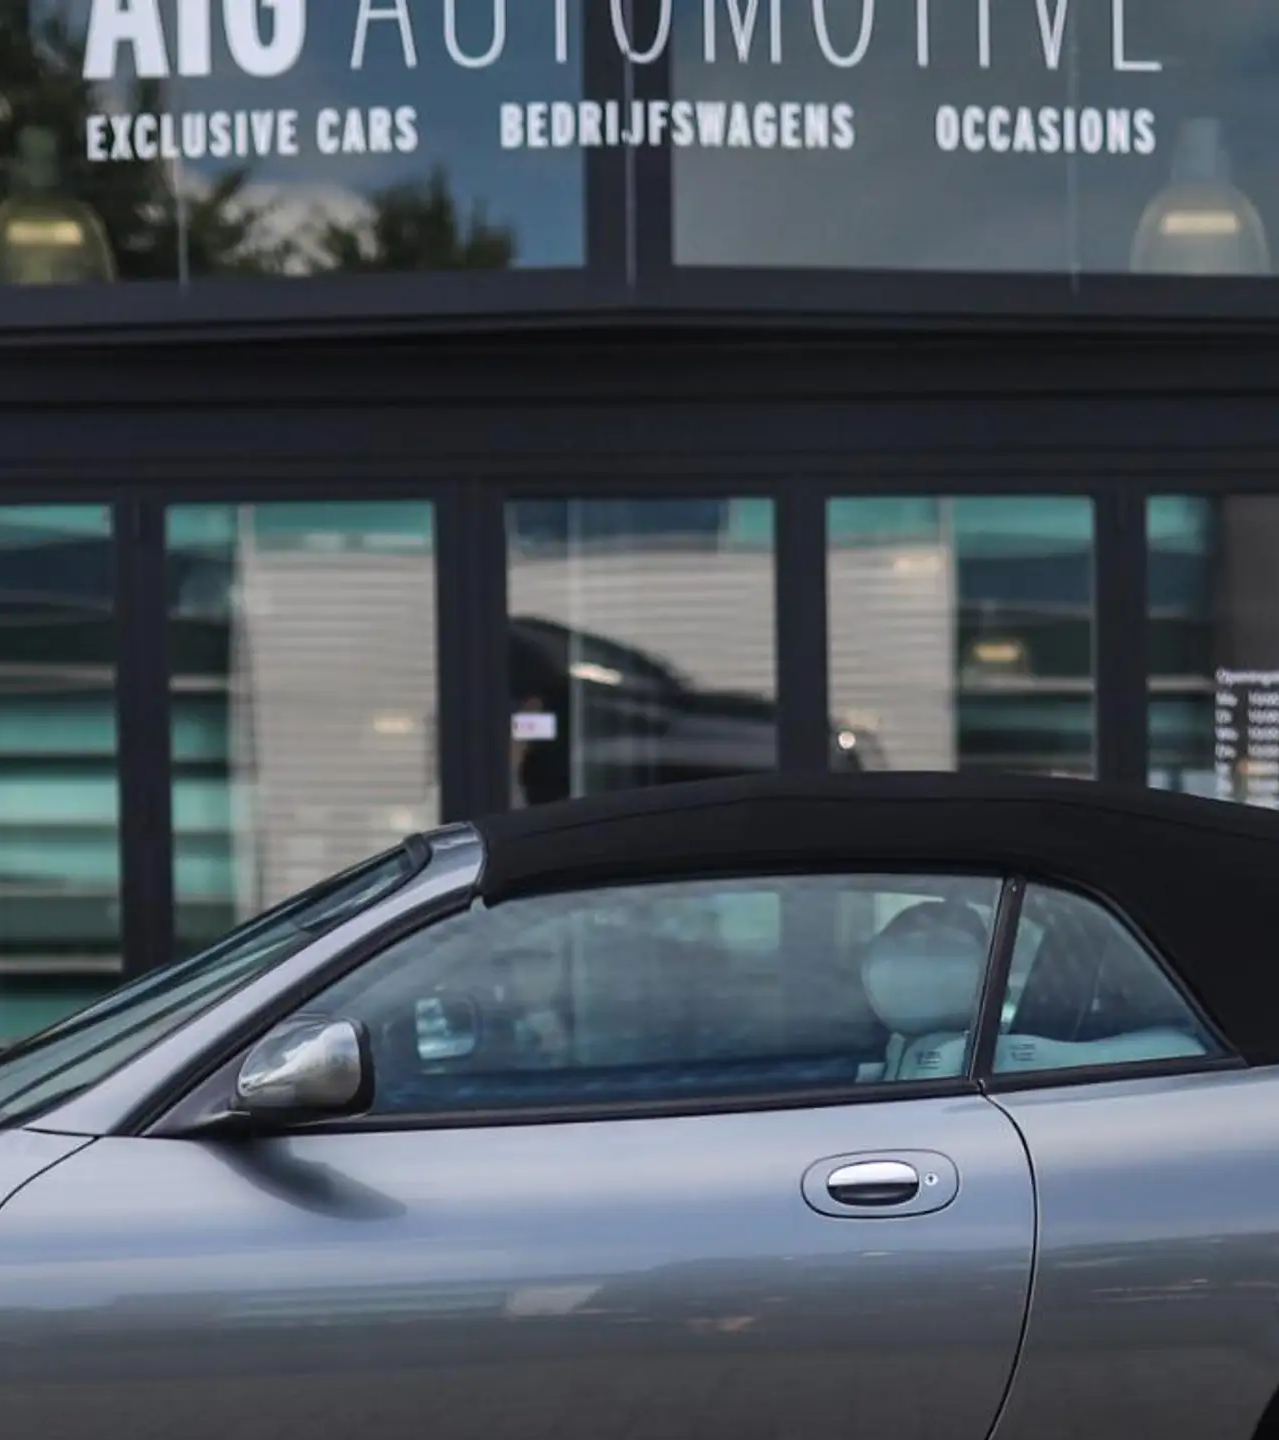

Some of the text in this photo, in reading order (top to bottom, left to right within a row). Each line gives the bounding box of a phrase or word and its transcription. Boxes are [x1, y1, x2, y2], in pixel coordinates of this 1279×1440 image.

[86, 101, 1156, 162] EXCLUSIVE CARS BEDRIJFSWAGENS OCCASIONS
